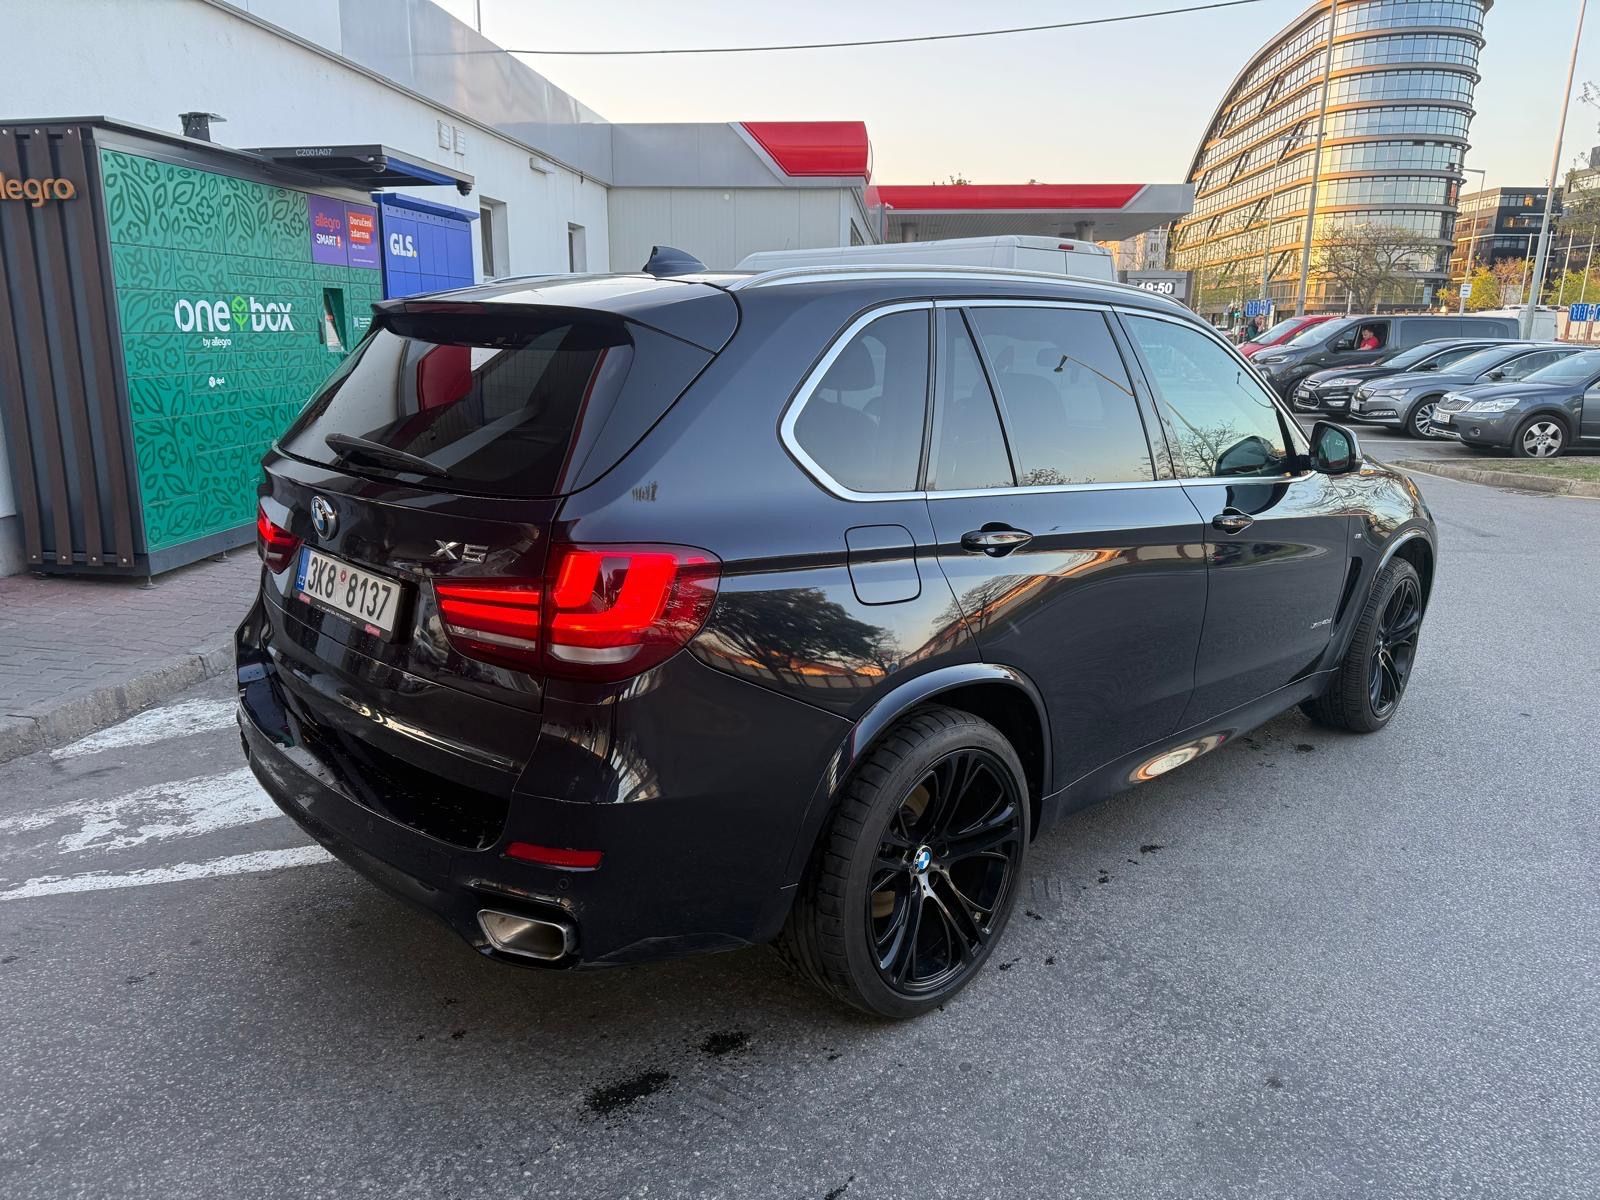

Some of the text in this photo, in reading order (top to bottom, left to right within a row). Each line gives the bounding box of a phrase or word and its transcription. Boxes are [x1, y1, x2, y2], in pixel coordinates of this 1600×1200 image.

[315, 212, 340, 232] allegro
[351, 229, 370, 240] zdarma
[203, 336, 231, 348] by allegro
[430, 540, 489, 563] X5
[308, 556, 336, 598] 3K8
[346, 573, 392, 620] 8137
